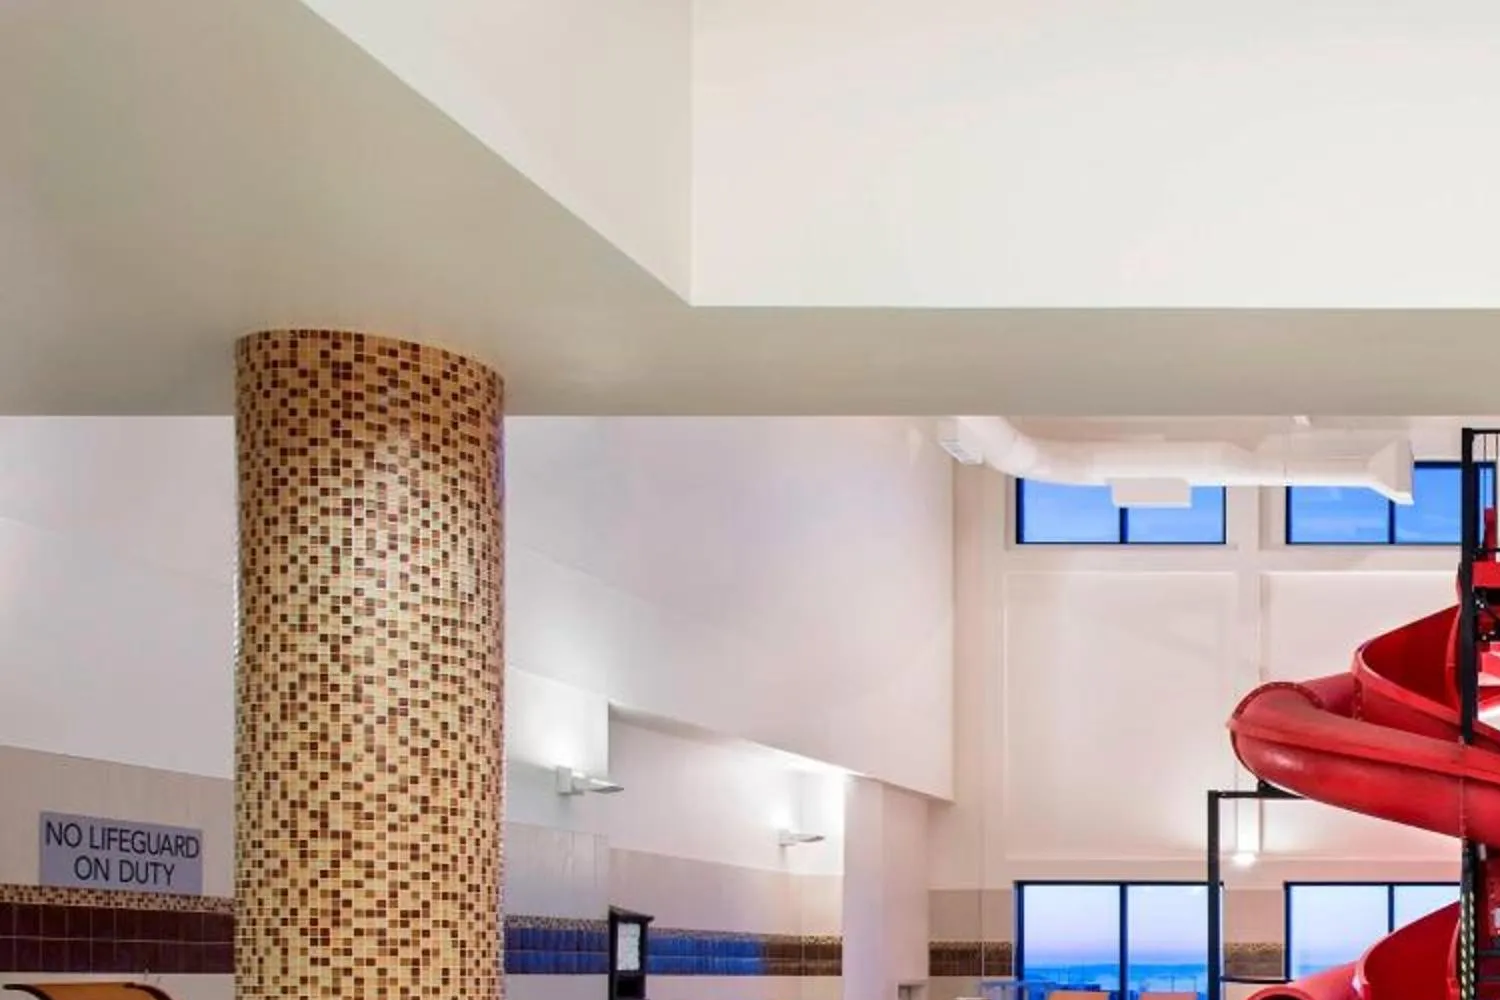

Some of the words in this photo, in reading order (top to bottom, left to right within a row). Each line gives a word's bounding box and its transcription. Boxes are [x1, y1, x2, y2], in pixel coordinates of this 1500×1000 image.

[45, 821, 83, 848] NO
[89, 825, 200, 859] LIFEGUARD
[74, 855, 110, 882] ON
[119, 858, 175, 887] DUTY
